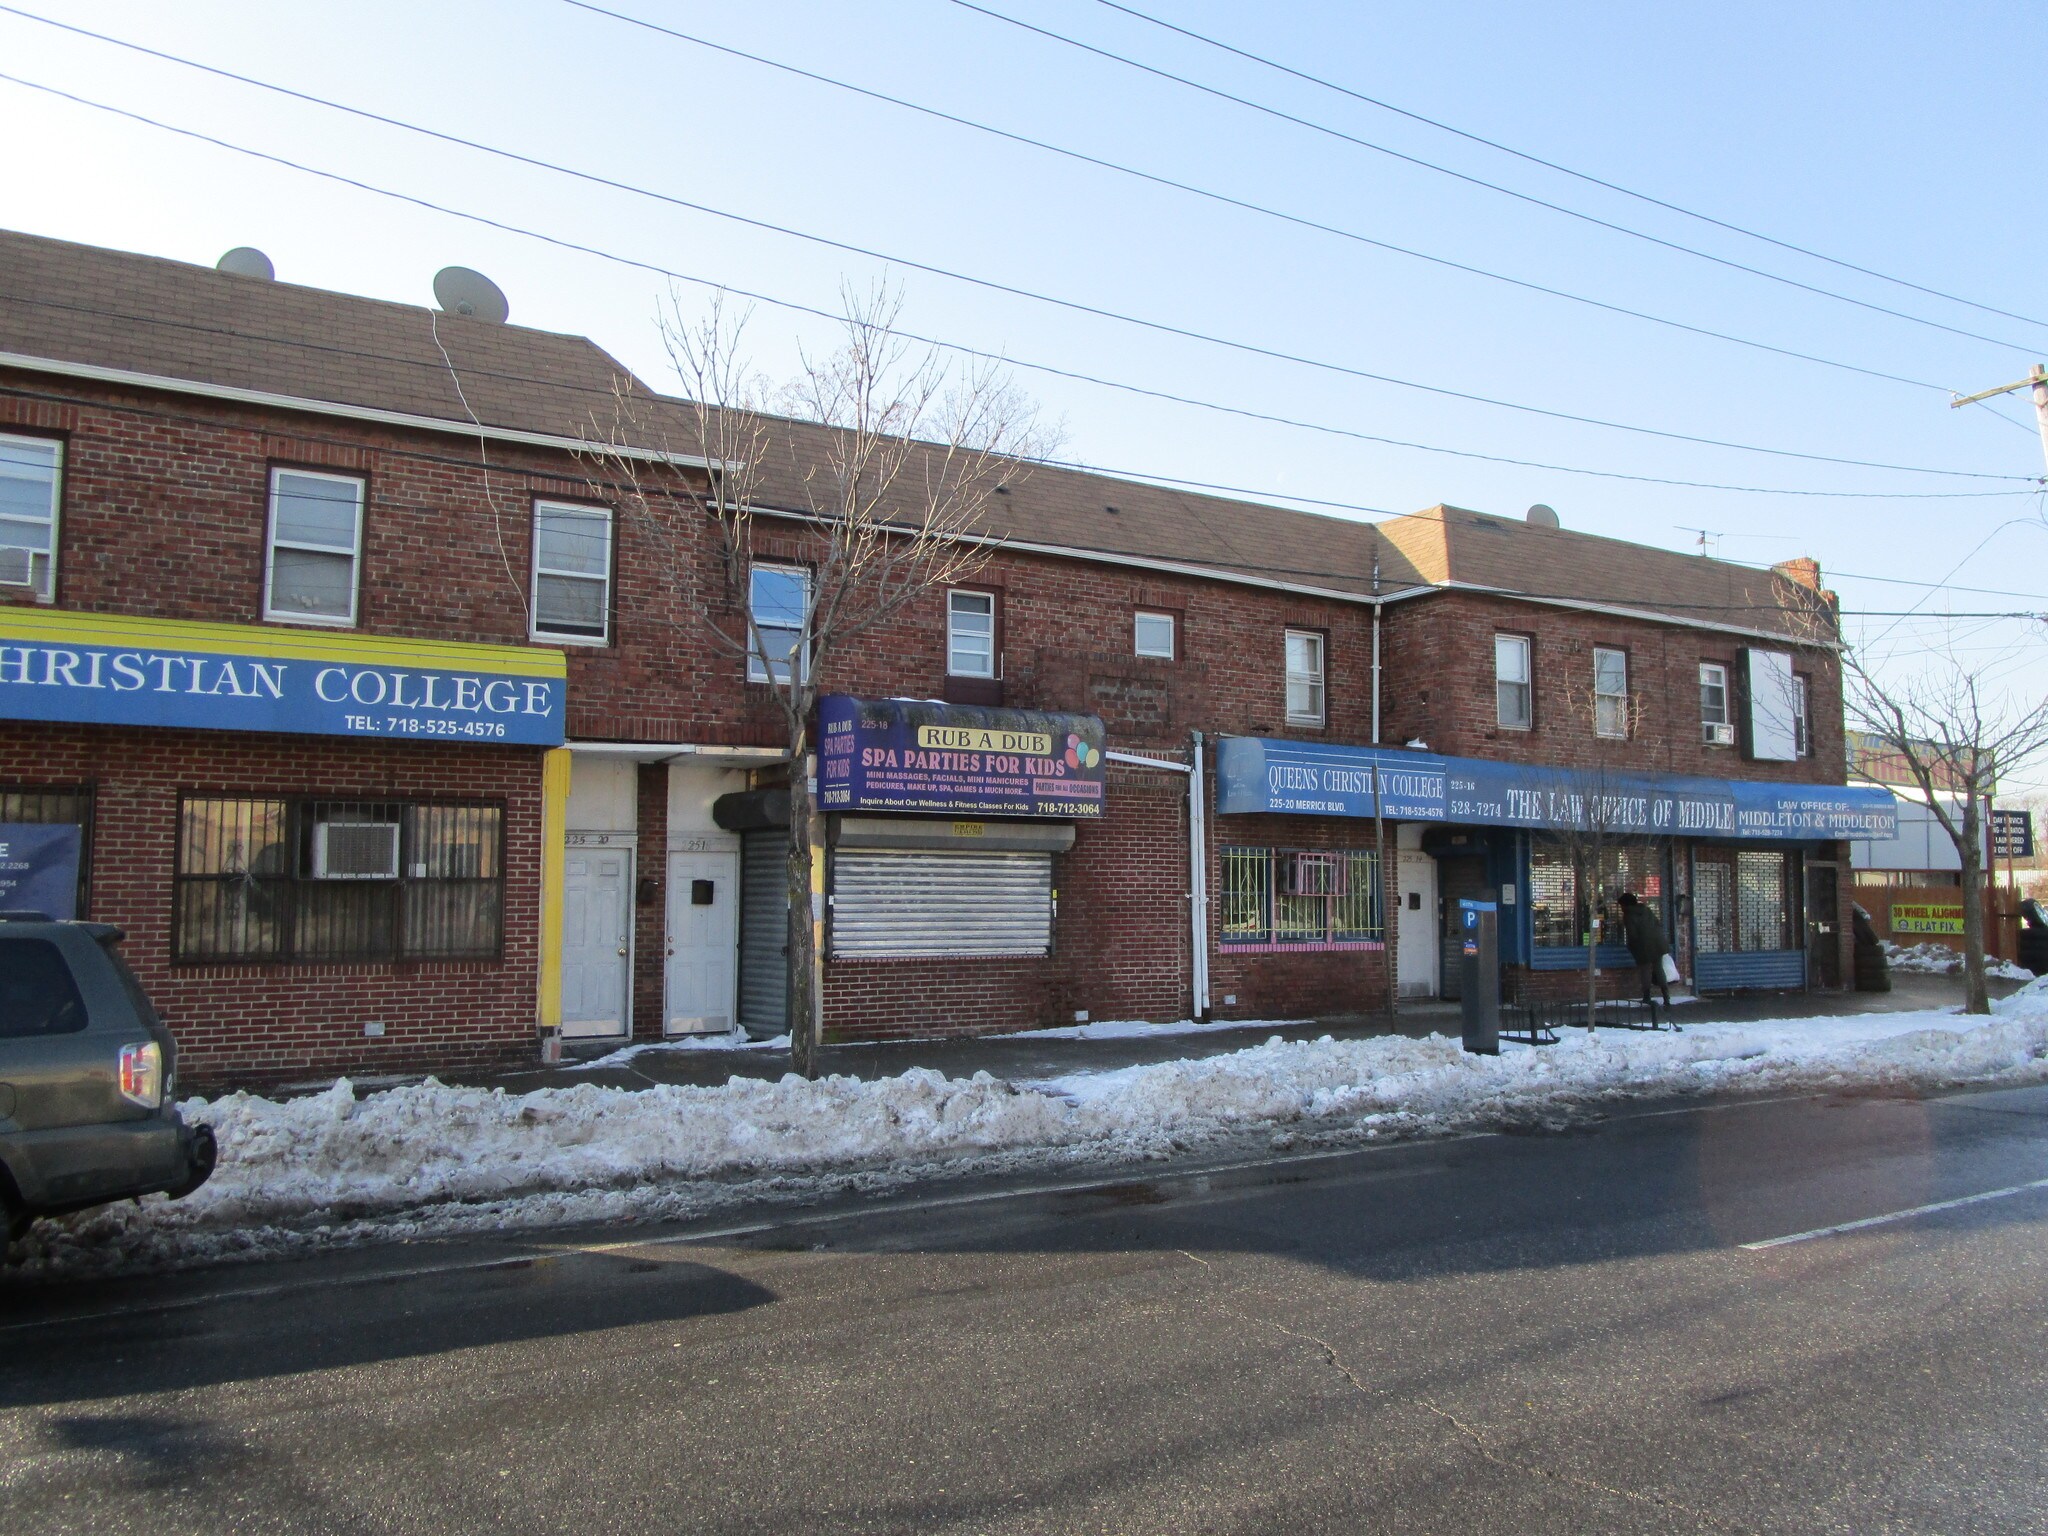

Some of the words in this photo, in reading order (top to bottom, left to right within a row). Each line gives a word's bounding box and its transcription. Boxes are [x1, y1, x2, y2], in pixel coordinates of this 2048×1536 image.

[315, 668, 553, 717] COLLEGE
[345, 715, 380, 731] TEL:
[387, 717, 505, 737] 718-525-4576
[861, 720, 888, 730] 225-18
[824, 737, 834, 757] SPA
[834, 734, 855, 755] PARTIES
[927, 729, 971, 746] RUB
[979, 732, 993, 748] A
[1002, 734, 1045, 751] DUB
[861, 747, 898, 767] SPA
[904, 750, 980, 772] PARTIES
[985, 755, 1020, 774] FOR
[1025, 757, 1065, 776] KIDS
[826, 760, 837, 779] FOR
[886, 772, 930, 781] MASSAGES,
[932, 774, 965, 783] FACIALS,
[986, 777, 1028, 786] MANICURES
[1269, 765, 1318, 795] QUEENS
[1324, 769, 1388, 795] CHRISTIN
[1392, 774, 1444, 799] COLLEGE
[1450, 780, 1476, 791] 225-16
[866, 781, 906, 791] PEDICURES,
[955, 785, 977, 793] GAMES
[1036, 782, 1054, 792] PARTIES
[1070, 784, 1099, 794] OCCASIONS
[860, 797, 883, 806] Inquire
[978, 802, 1002, 810] Classes
[1015, 803, 1028, 811] Kids
[1037, 802, 1100, 814] 718-712-3064
[1270, 798, 1294, 809] 225-20
[1296, 799, 1326, 811] MERRICK
[1328, 802, 1346, 812] BLVD.
[1385, 805, 1398, 815] TEL:
[1400, 806, 1444, 818] 718-525-4576
[1451, 800, 1501, 817] 528-7274
[1506, 789, 1542, 820] THE
[1548, 792, 1584, 824] LAW
[1590, 795, 1647, 826] OFFICE
[1653, 799, 1673, 827] OF
[1778, 801, 1798, 810] LAW
[1800, 802, 1832, 811] OFFICE
[1738, 811, 1812, 828] MIDDLETON
[1815, 812, 1824, 828] &
[1829, 814, 1895, 829] MIDDLETON
[1468, 912, 1476, 926] P
[1904, 907, 1930, 918] WHEEL
[1914, 921, 1936, 932] FLAT
[1940, 921, 1955, 932] FIX
